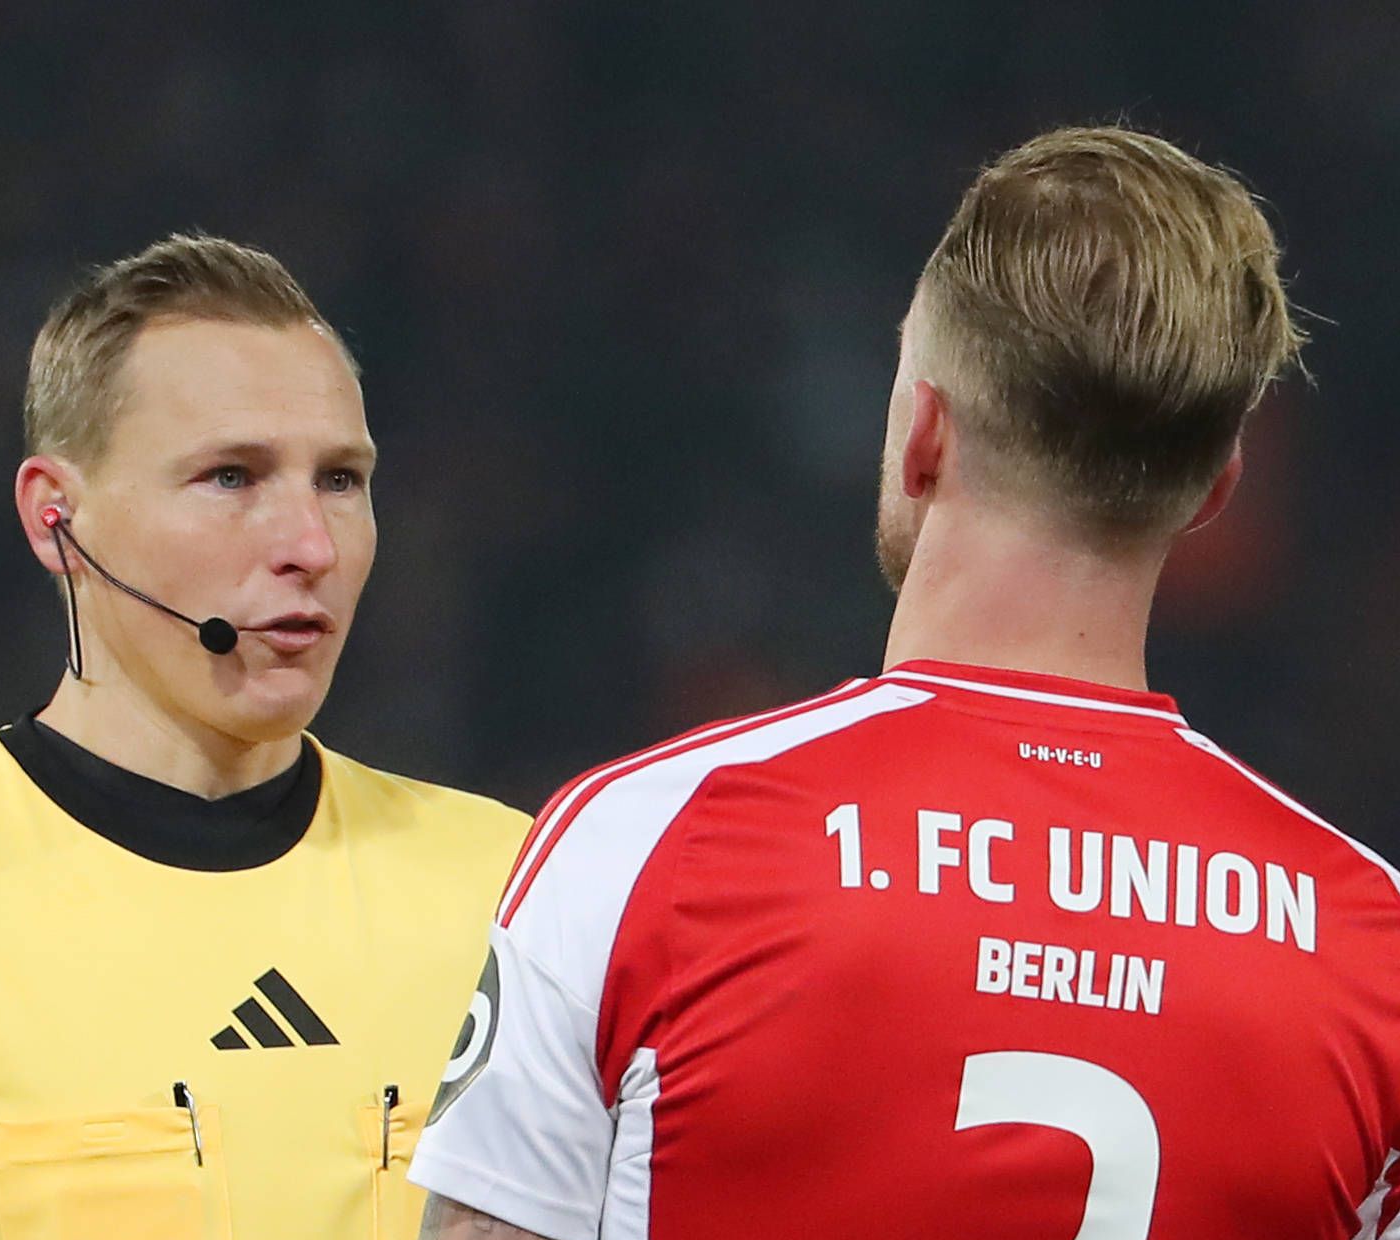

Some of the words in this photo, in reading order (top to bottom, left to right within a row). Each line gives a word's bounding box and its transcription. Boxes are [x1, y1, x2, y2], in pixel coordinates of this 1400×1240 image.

[824, 802, 891, 890] 1.
[916, 808, 1014, 903] FC
[1047, 826, 1317, 953] UNION
[976, 936, 1165, 1015] BERLIN
